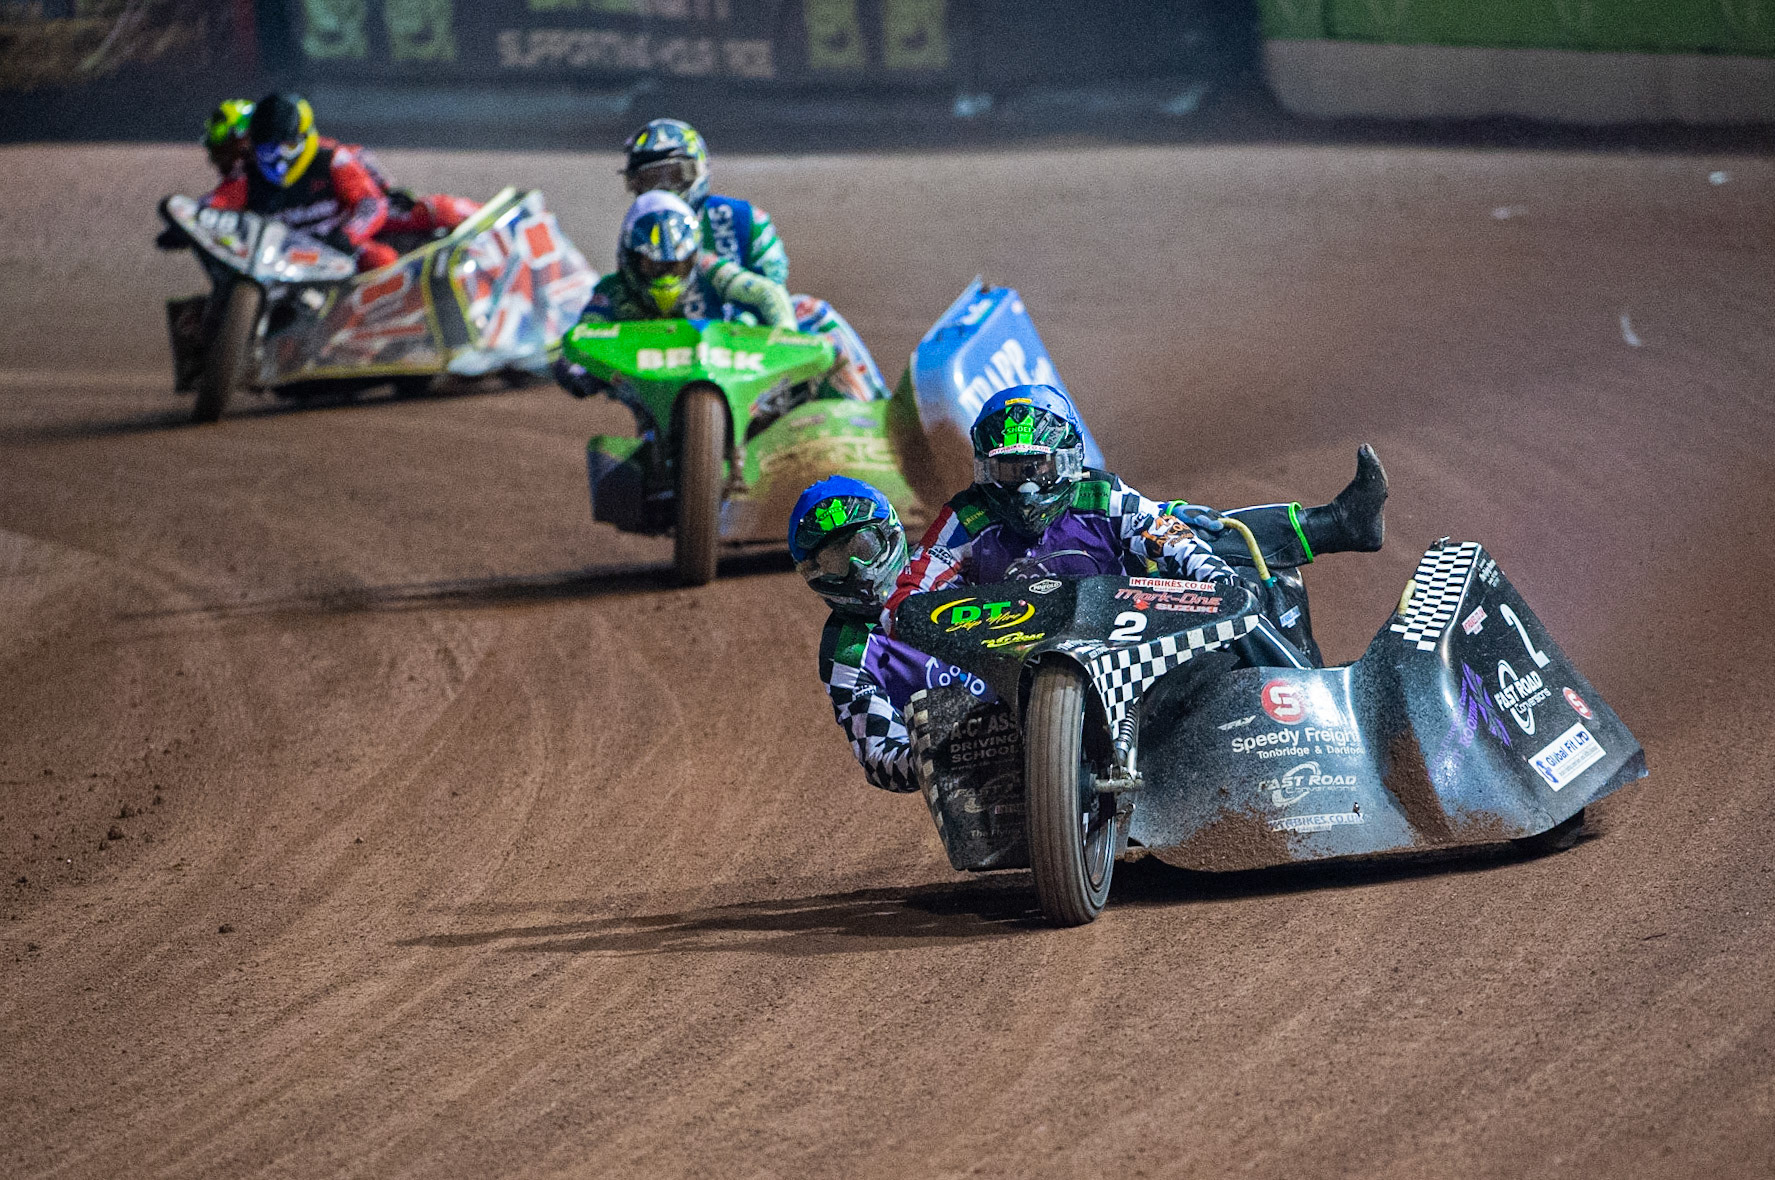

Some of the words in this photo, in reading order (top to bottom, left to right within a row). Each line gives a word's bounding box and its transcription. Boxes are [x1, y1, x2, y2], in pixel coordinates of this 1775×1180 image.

[1131, 578, 1214, 590] INTABIKES.CO.UK
[951, 601, 1011, 624] DT
[1154, 603, 1218, 613] SUZUKI
[1108, 611, 1147, 641] 2
[1500, 604, 1550, 668] 2
[1494, 683, 1517, 711] FAST
[1515, 670, 1543, 699] ROAD
[950, 712, 1019, 740] A-CASS
[951, 733, 1018, 753] DRIVING
[1231, 728, 1299, 753] Speedy
[1564, 739, 1578, 753] Fit
[952, 745, 1017, 763] SCHOOL
[1257, 745, 1309, 759] Tonbridge
[1314, 745, 1322, 754] &
[1258, 775, 1303, 792] FAST
[1309, 775, 1357, 785] ROAD
